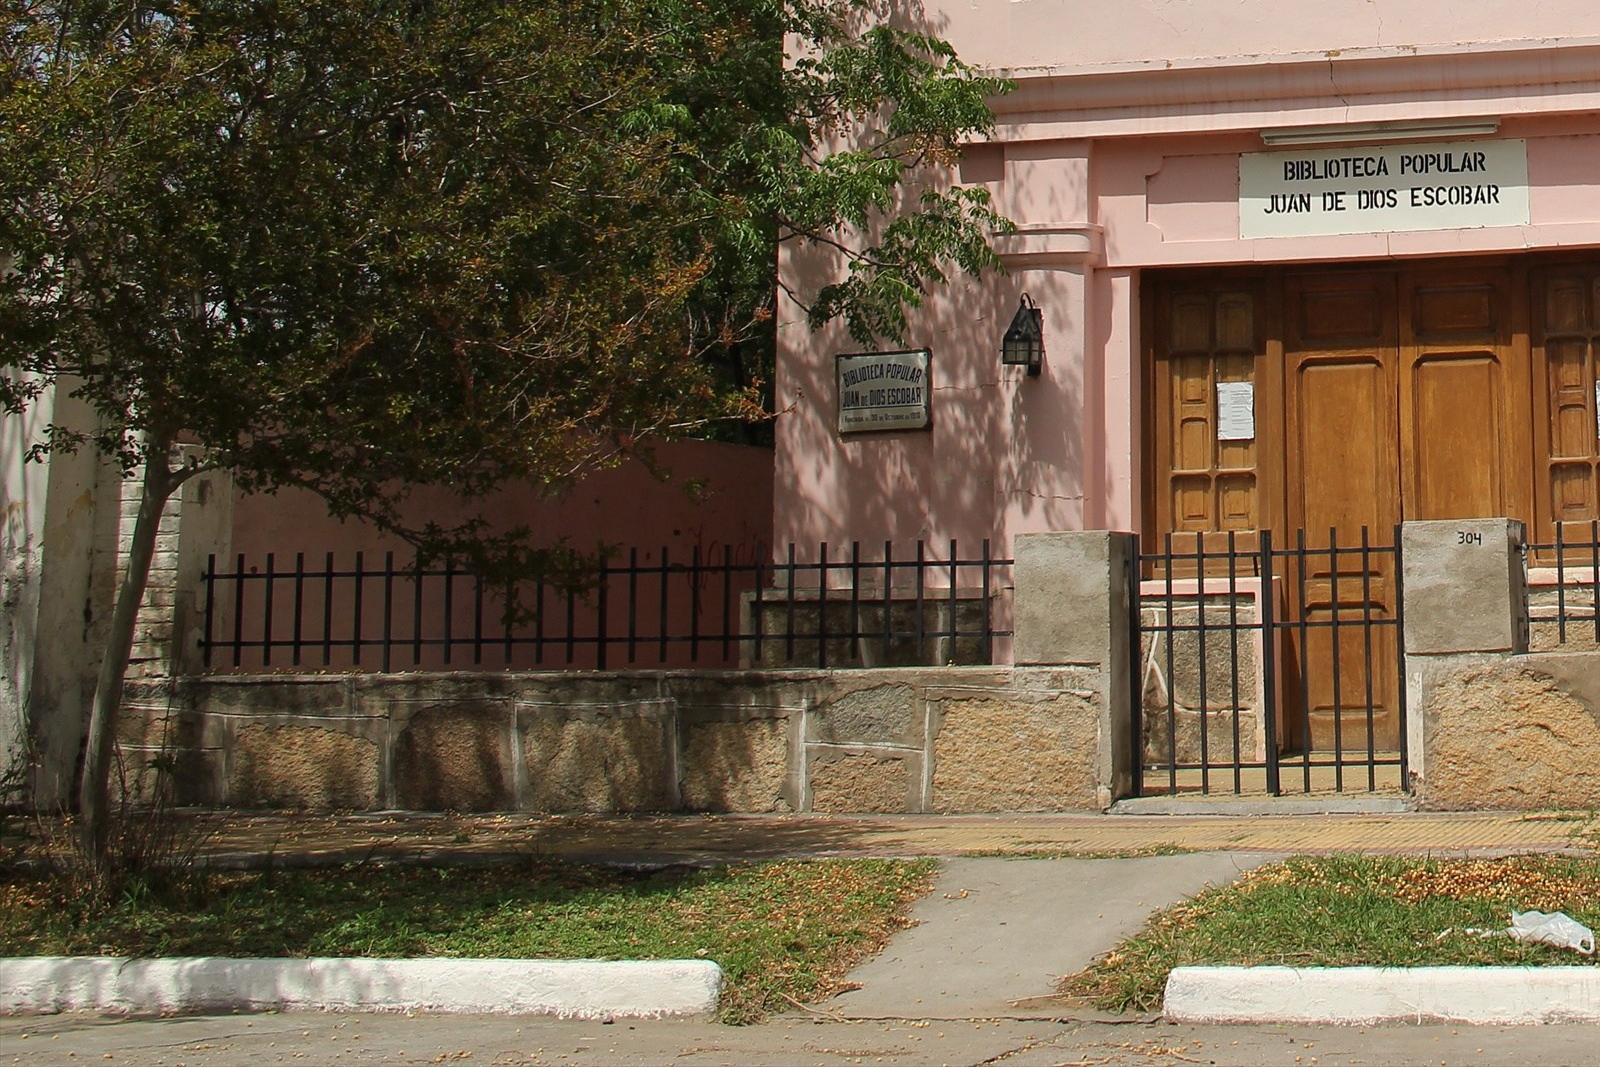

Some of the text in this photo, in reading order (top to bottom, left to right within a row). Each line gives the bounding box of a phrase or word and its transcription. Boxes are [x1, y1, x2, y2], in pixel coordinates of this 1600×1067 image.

[1283, 152, 1486, 181] BIBLIOTECA POPULAR
[1263, 184, 1500, 214] JUAN DE DIOS ESCOBAR
[842, 363, 922, 388] BIBLIOTECA POPULAR
[860, 395, 868, 406] DE
[869, 388, 886, 406] DIOS
[1457, 531, 1482, 546] 304
